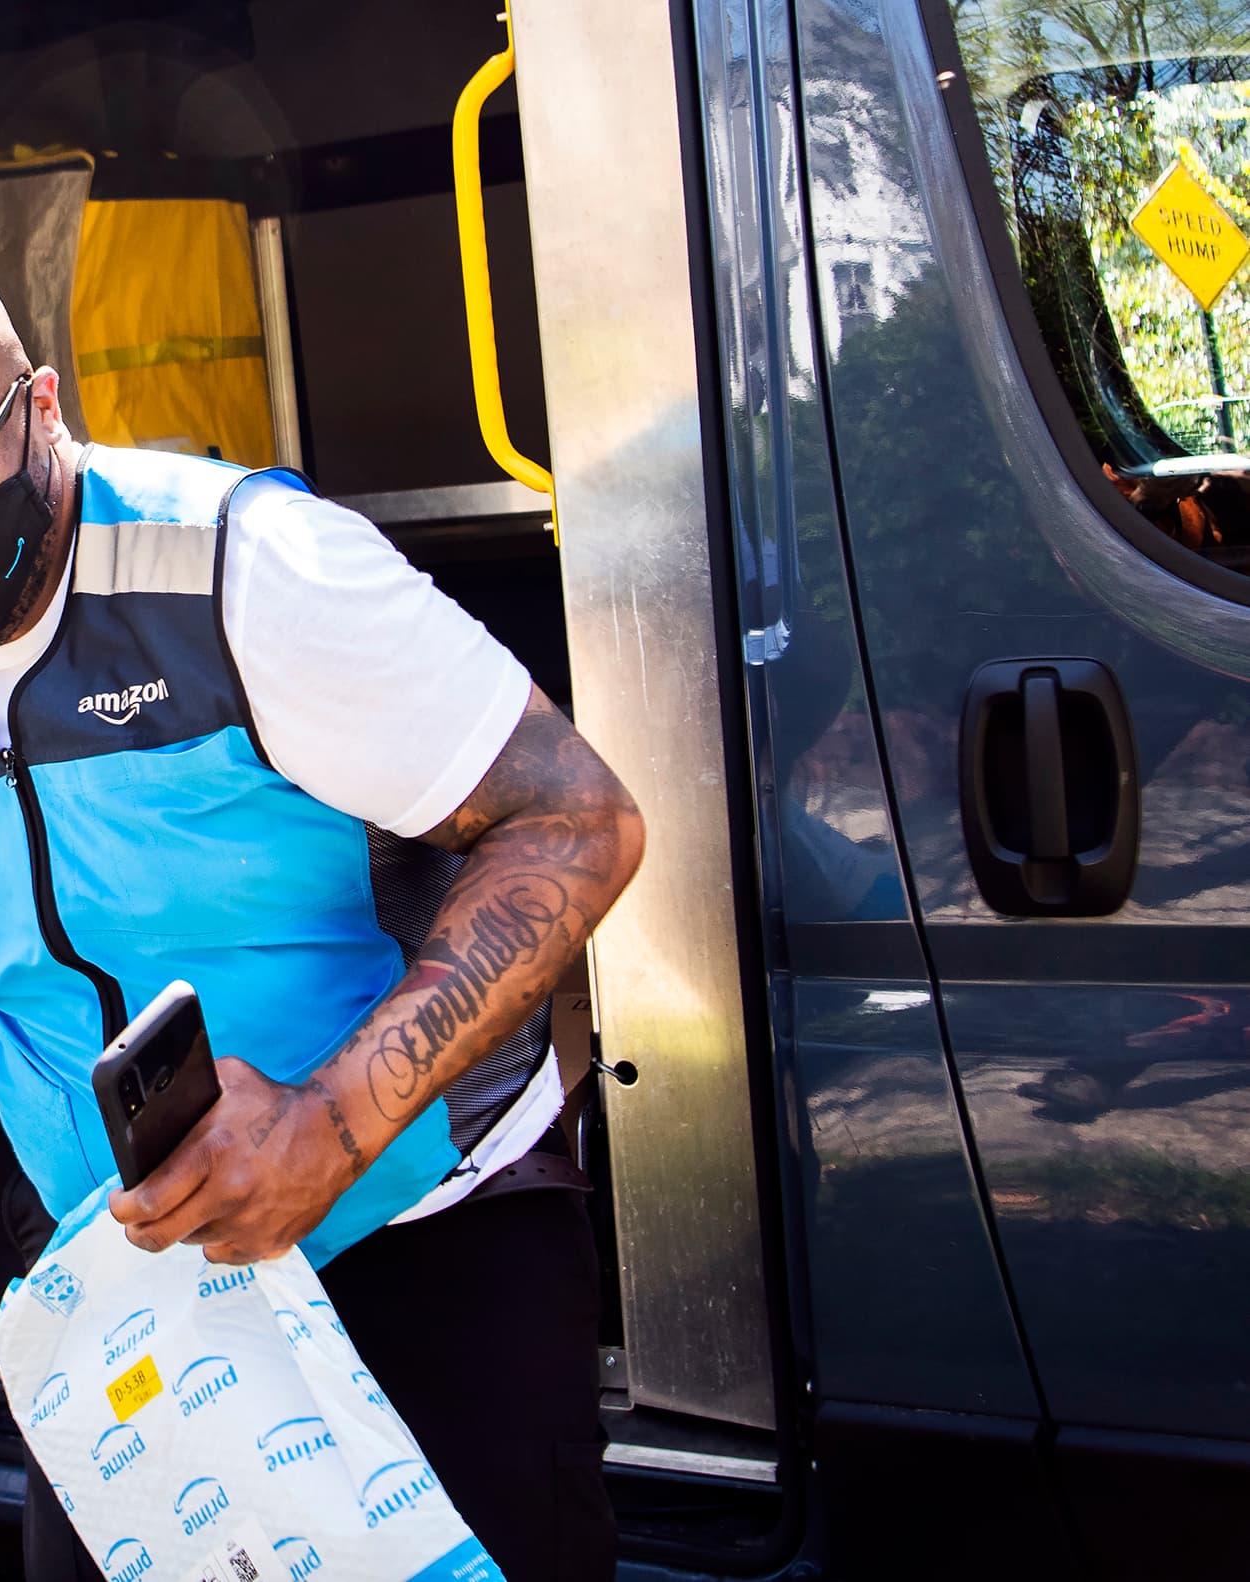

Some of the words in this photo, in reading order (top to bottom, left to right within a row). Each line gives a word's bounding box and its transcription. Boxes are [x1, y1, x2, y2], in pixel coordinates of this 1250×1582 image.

[1159, 207, 1221, 237] SPEED
[1167, 234, 1221, 261] HUMP
[78, 678, 169, 713] amazon
[199, 1266, 256, 1298] rime
[105, 1314, 156, 1366] prime
[30, 1379, 70, 1428] prime
[180, 1364, 238, 1417] prime
[100, 1431, 146, 1481] prime
[182, 1486, 230, 1536] prime
[366, 1466, 438, 1529] prime
